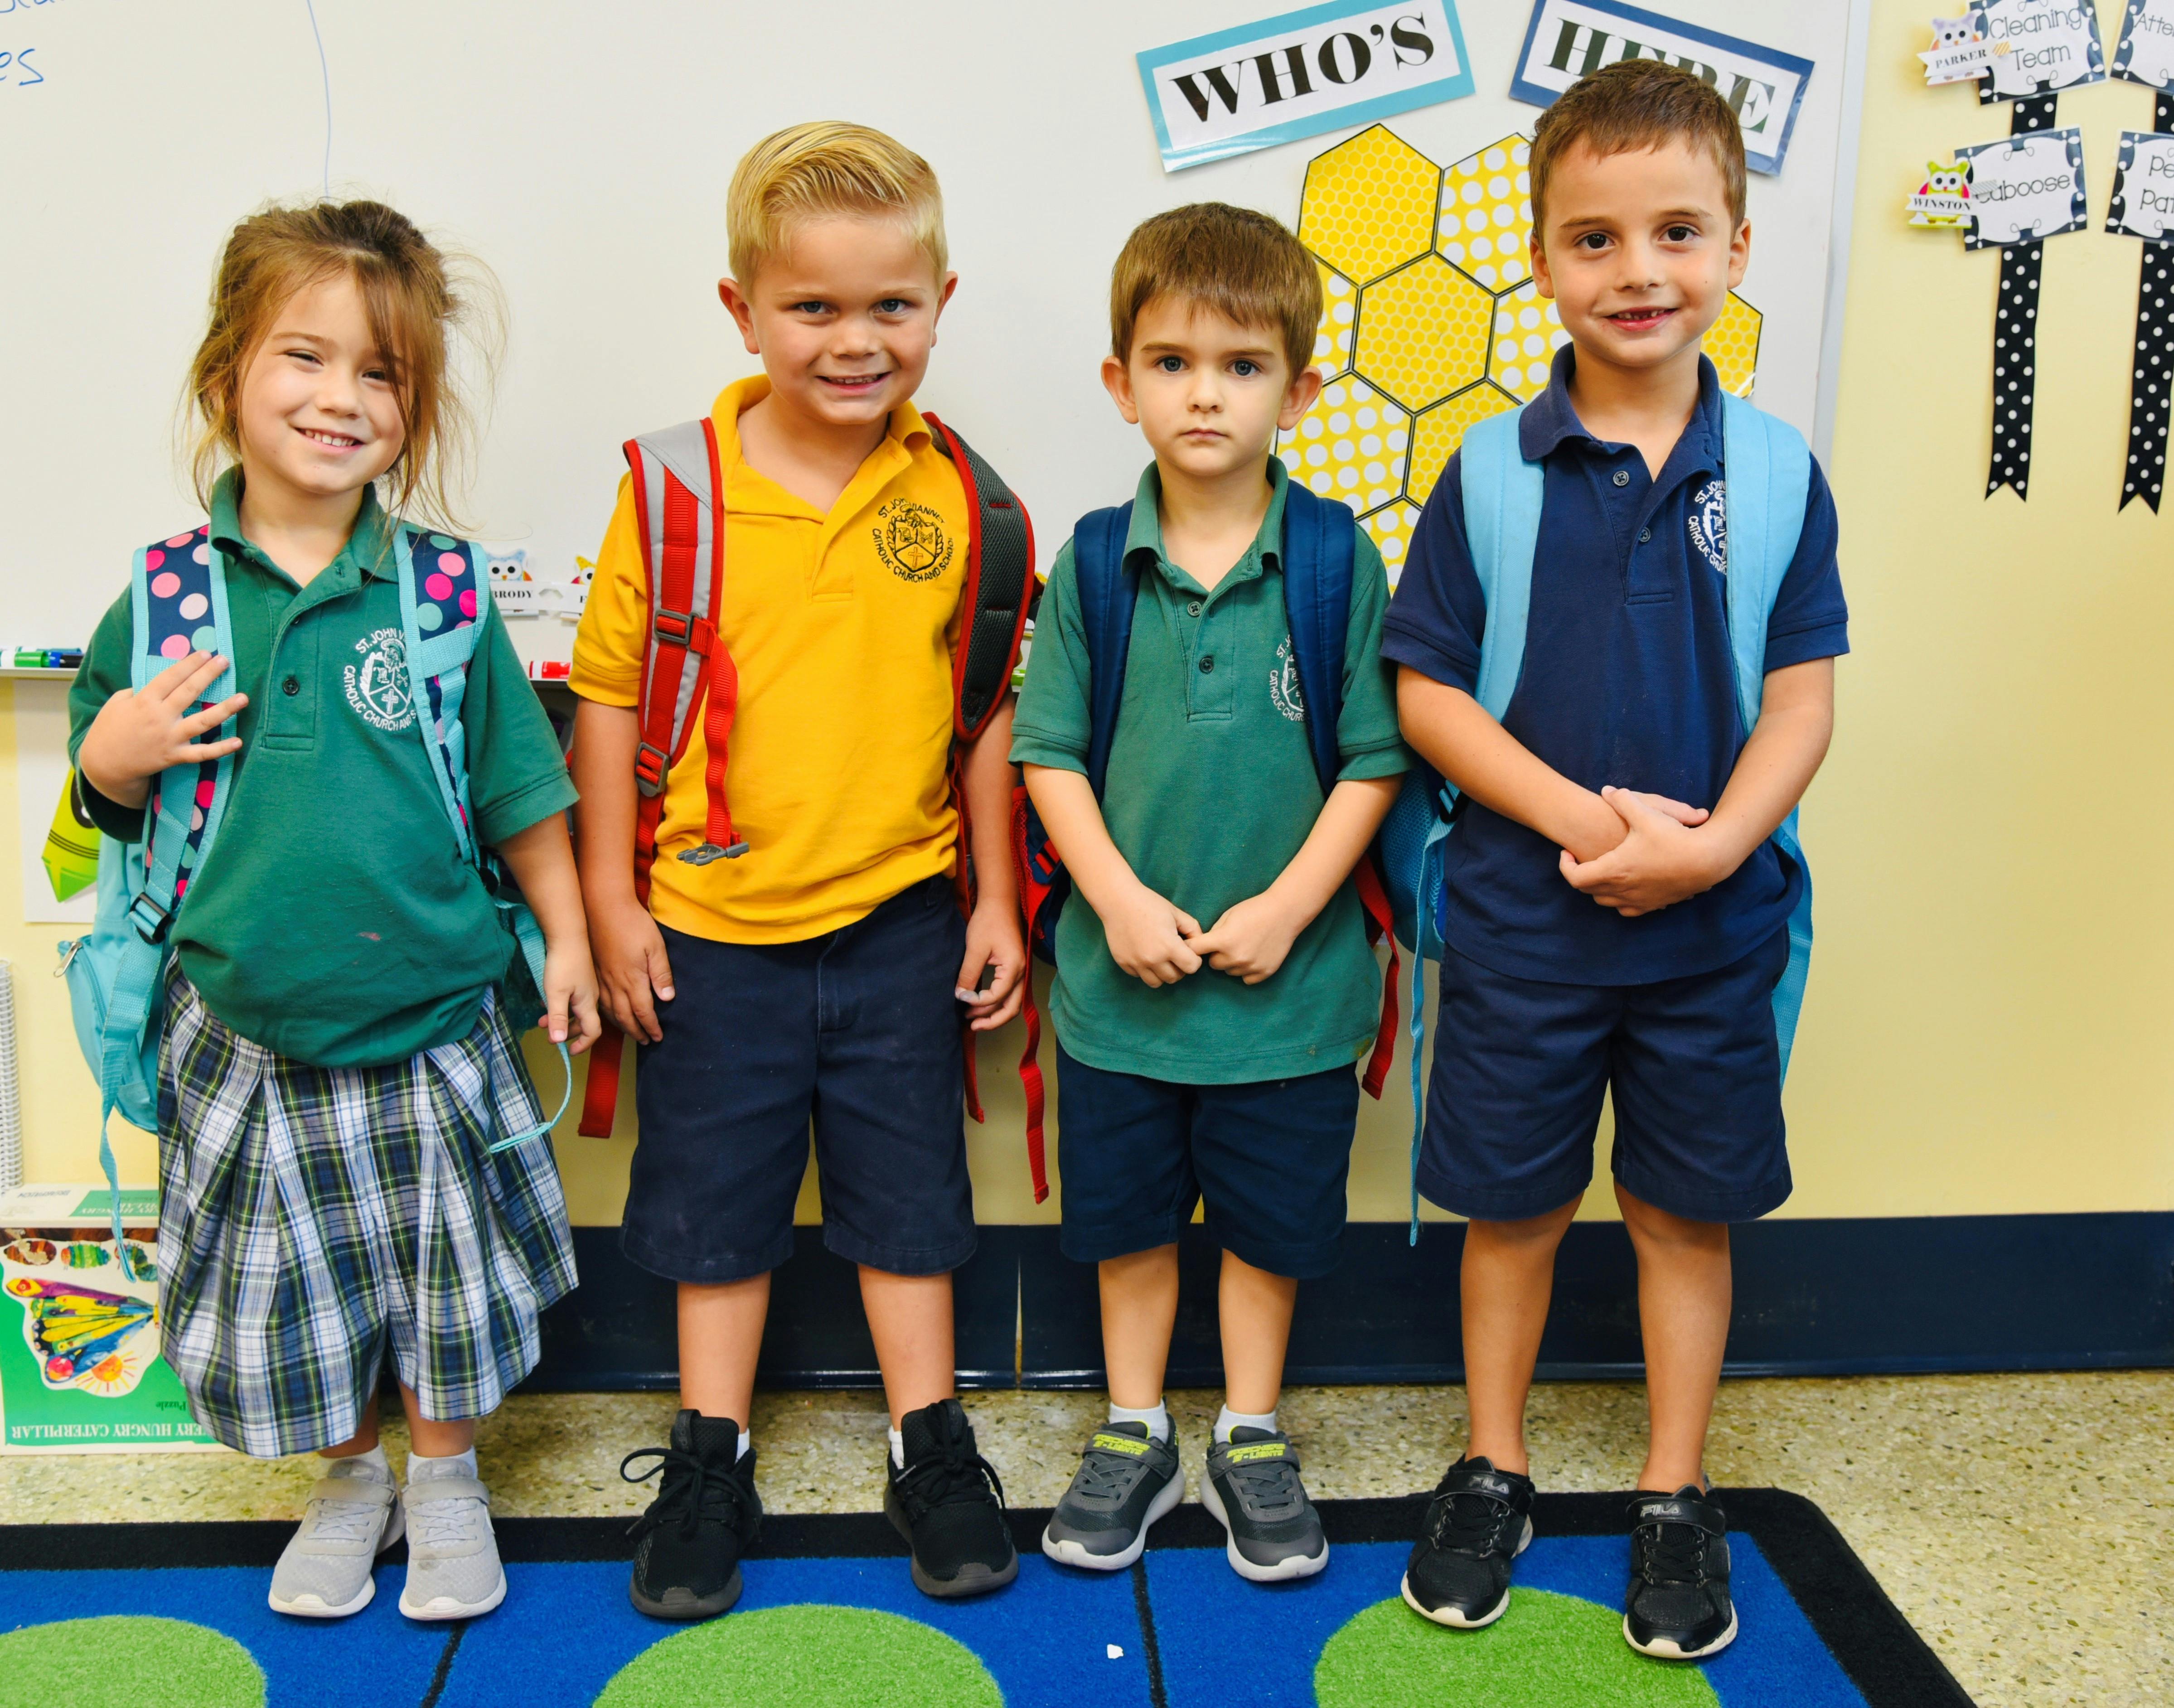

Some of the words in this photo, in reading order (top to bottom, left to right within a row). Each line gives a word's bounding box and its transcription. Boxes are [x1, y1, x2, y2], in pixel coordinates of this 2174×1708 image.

[1990, 8, 2082, 39] Cleaning
[1169, 11, 1434, 123] WHO'S
[1936, 49, 1987, 68] PARKER
[2011, 45, 2071, 70] Team
[1544, 17, 1776, 134] HE
[1914, 198, 1972, 211] WINSTON
[872, 528, 894, 569] CATHOLIC
[893, 566, 924, 583] CHURCH
[925, 568, 941, 581] AND
[1688, 515, 1711, 557] CATHOLIC
[1709, 554, 1727, 576] CHURC
[370, 628, 397, 644] JOHN
[344, 665, 367, 713] CATHOLIC
[363, 709, 399, 731] CHURCH
[399, 716, 412, 731] AND
[1269, 670, 1285, 711] CATHOLIC
[1282, 707, 1305, 721] CHURC
[155, 1401, 187, 1411] Puzzle
[11, 1423, 110, 1439] CATERPILLAR
[112, 1423, 172, 1437] HUNGRY
[175, 1423, 207, 1436] ERY
[1468, 1474, 1510, 1495] FILA
[1640, 1501, 1682, 1518] FILA
